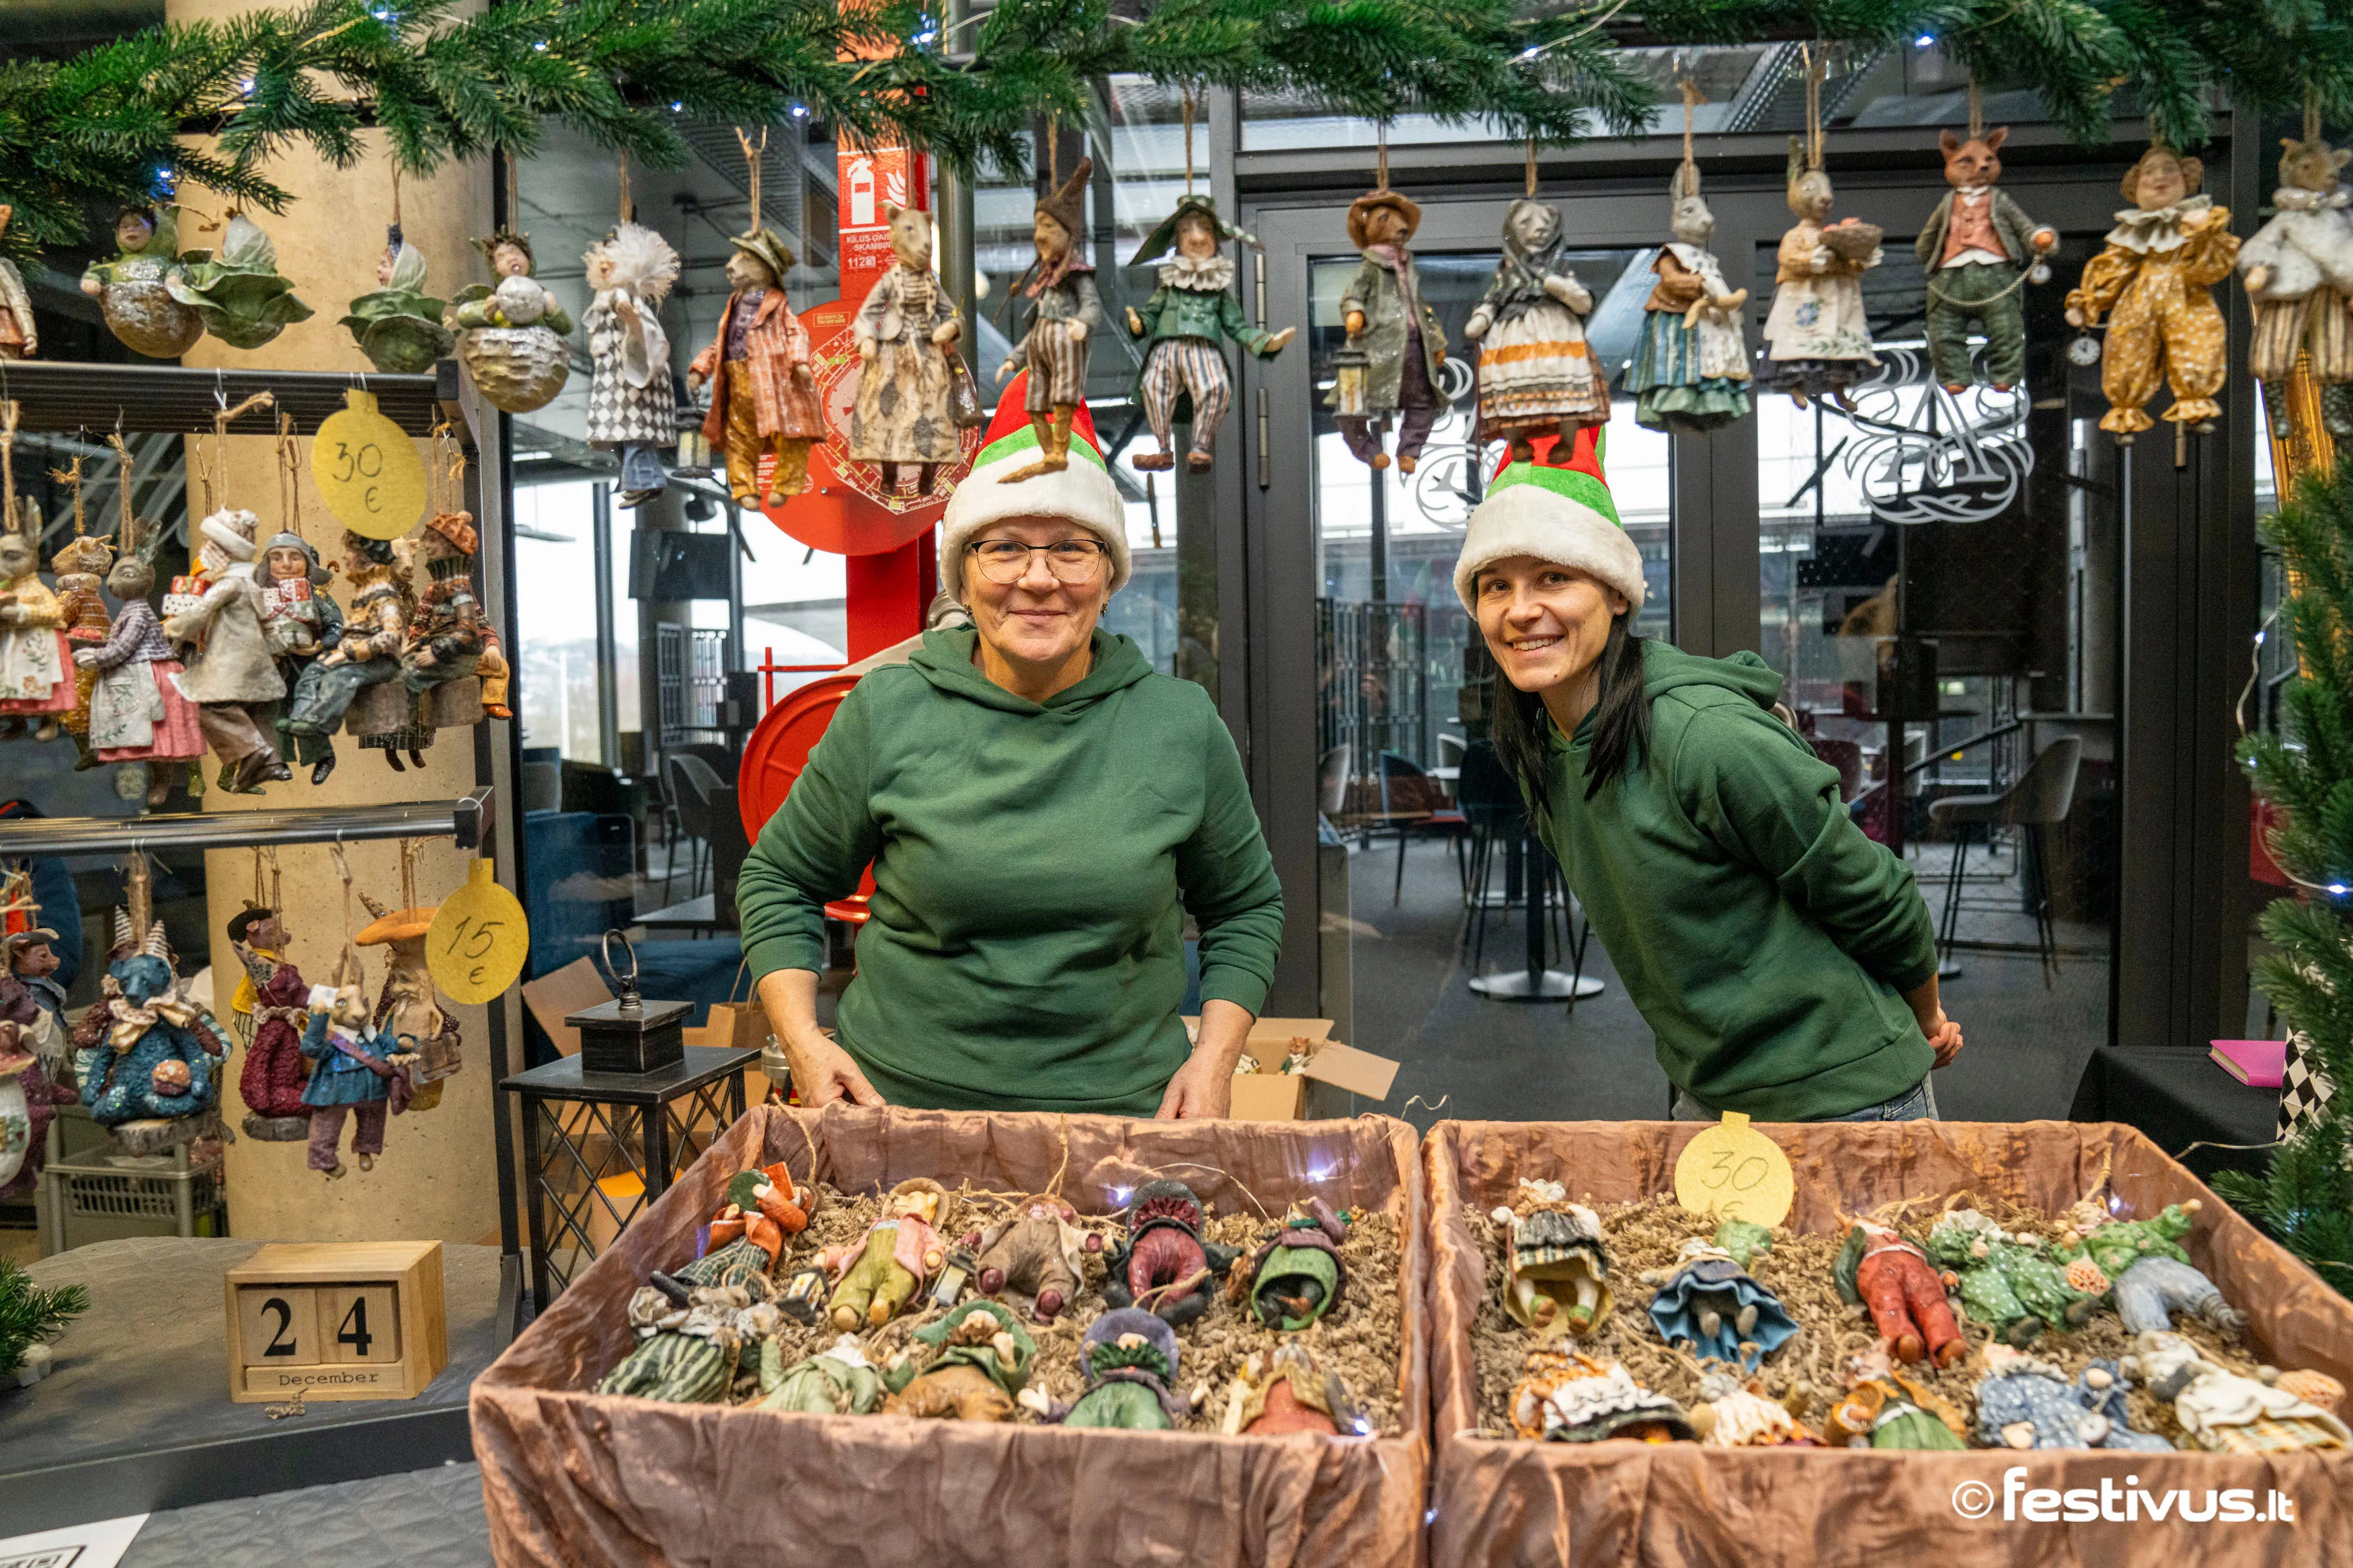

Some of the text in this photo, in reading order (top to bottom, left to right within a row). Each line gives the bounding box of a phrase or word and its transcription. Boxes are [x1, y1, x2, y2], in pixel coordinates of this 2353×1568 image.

[854, 241, 891, 251] SKAMBIN
[847, 256, 866, 268] 112
[332, 442, 383, 483] 30
[447, 916, 505, 959] 15
[1700, 1151, 1769, 1192] 30
[279, 1372, 379, 1387] December
